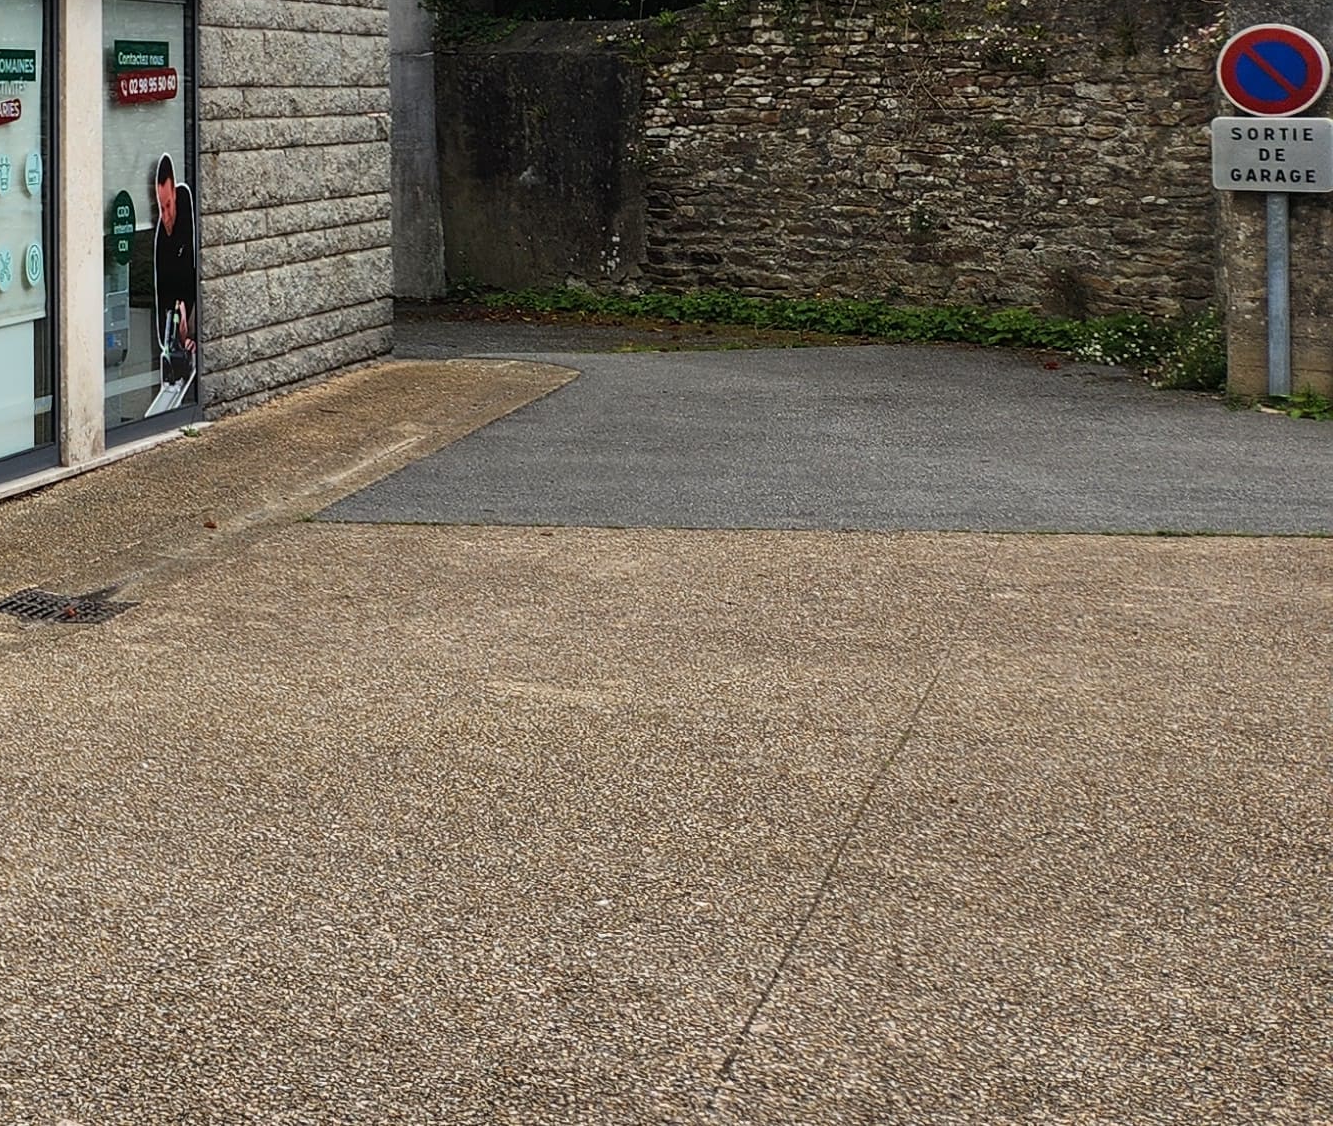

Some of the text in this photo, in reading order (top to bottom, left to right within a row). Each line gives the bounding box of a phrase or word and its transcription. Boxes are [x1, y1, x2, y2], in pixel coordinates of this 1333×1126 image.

[118, 52, 165, 66] Contactez nous
[129, 78, 139, 94] 02
[1230, 127, 1314, 142] SORTIE
[1258, 148, 1286, 162] DE
[1230, 168, 1317, 184] GARAGE
